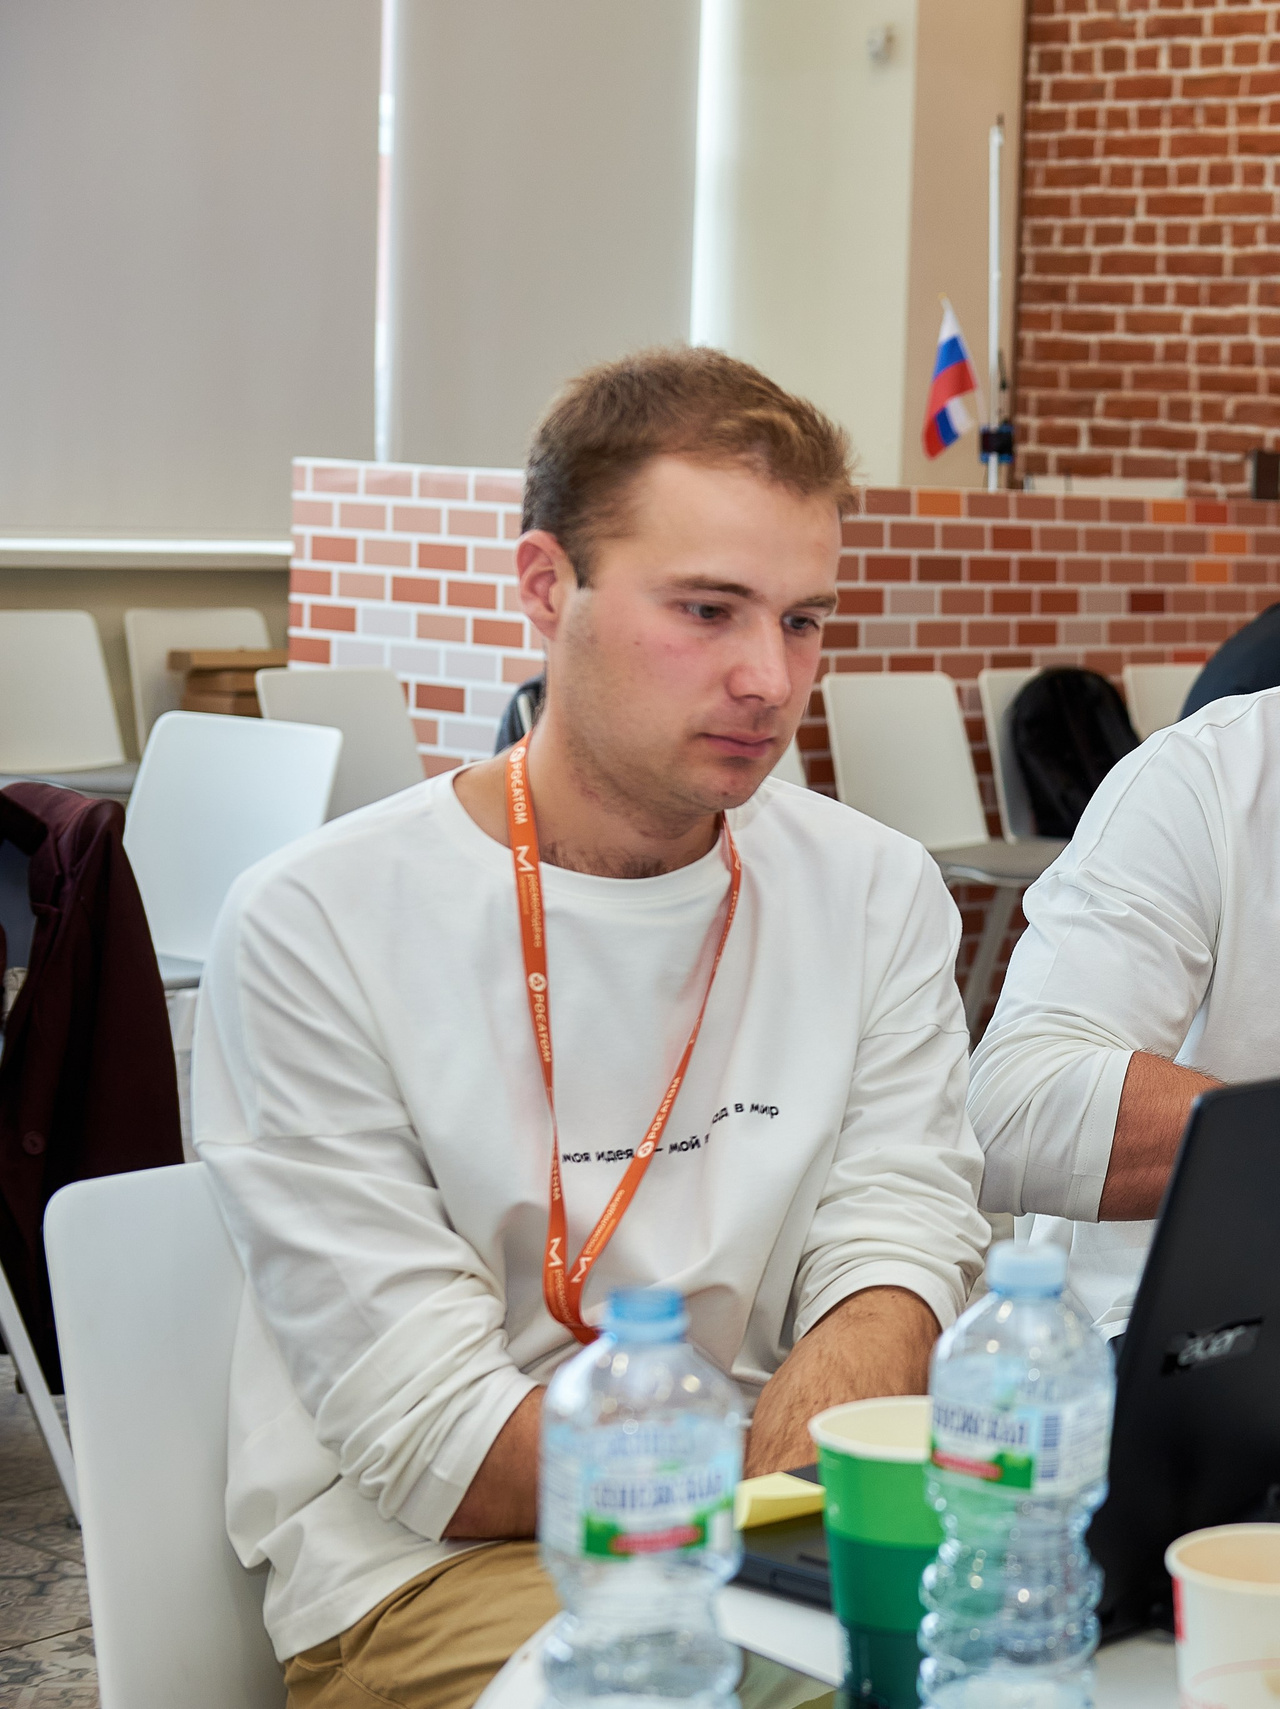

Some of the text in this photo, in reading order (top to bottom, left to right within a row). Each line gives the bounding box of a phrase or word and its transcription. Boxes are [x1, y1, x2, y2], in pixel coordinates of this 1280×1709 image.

[510, 762, 528, 825] РОСАТОМ
[561, 1152, 591, 1163] моя
[596, 1148, 635, 1162] идея
[668, 1134, 701, 1154] мой
[749, 1103, 780, 1119] мир
